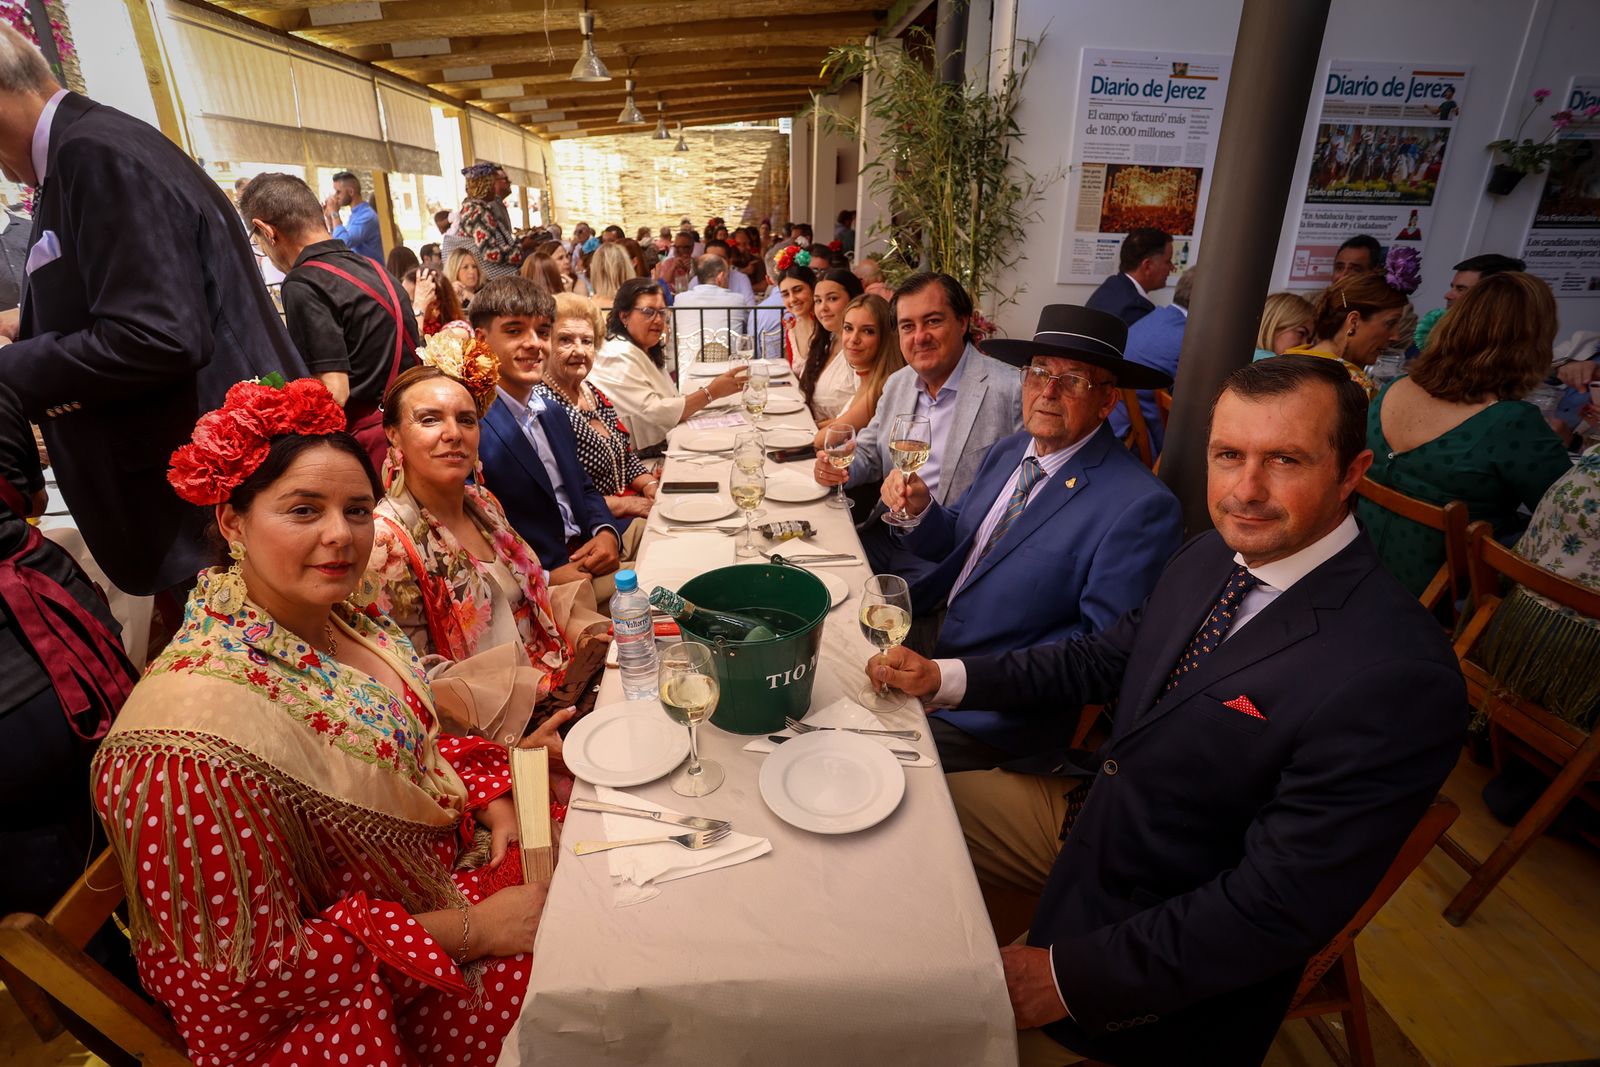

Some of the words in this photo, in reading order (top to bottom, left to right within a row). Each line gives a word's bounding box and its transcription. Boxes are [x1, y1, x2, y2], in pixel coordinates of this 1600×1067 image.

[1091, 75, 1139, 96] Diario
[1142, 79, 1163, 98] de
[1164, 80, 1207, 103] Jerez
[1325, 74, 1379, 95] Diario
[1382, 76, 1405, 97] de
[1405, 77, 1453, 103] Jerez
[1568, 91, 1600, 111] Dia
[1088, 109, 1097, 120] El
[1098, 113, 1129, 123] campo
[1168, 112, 1186, 124] más
[1086, 124, 1098, 135] de
[1100, 125, 1136, 136] 105.000
[1137, 126, 1175, 139] millones
[1344, 213, 1355, 222] hay
[1356, 214, 1367, 222] que
[1527, 238, 1541, 247] Los
[1541, 237, 1580, 247] candidatos
[1567, 249, 1597, 259] mejorar
[766, 664, 806, 690] TIO
